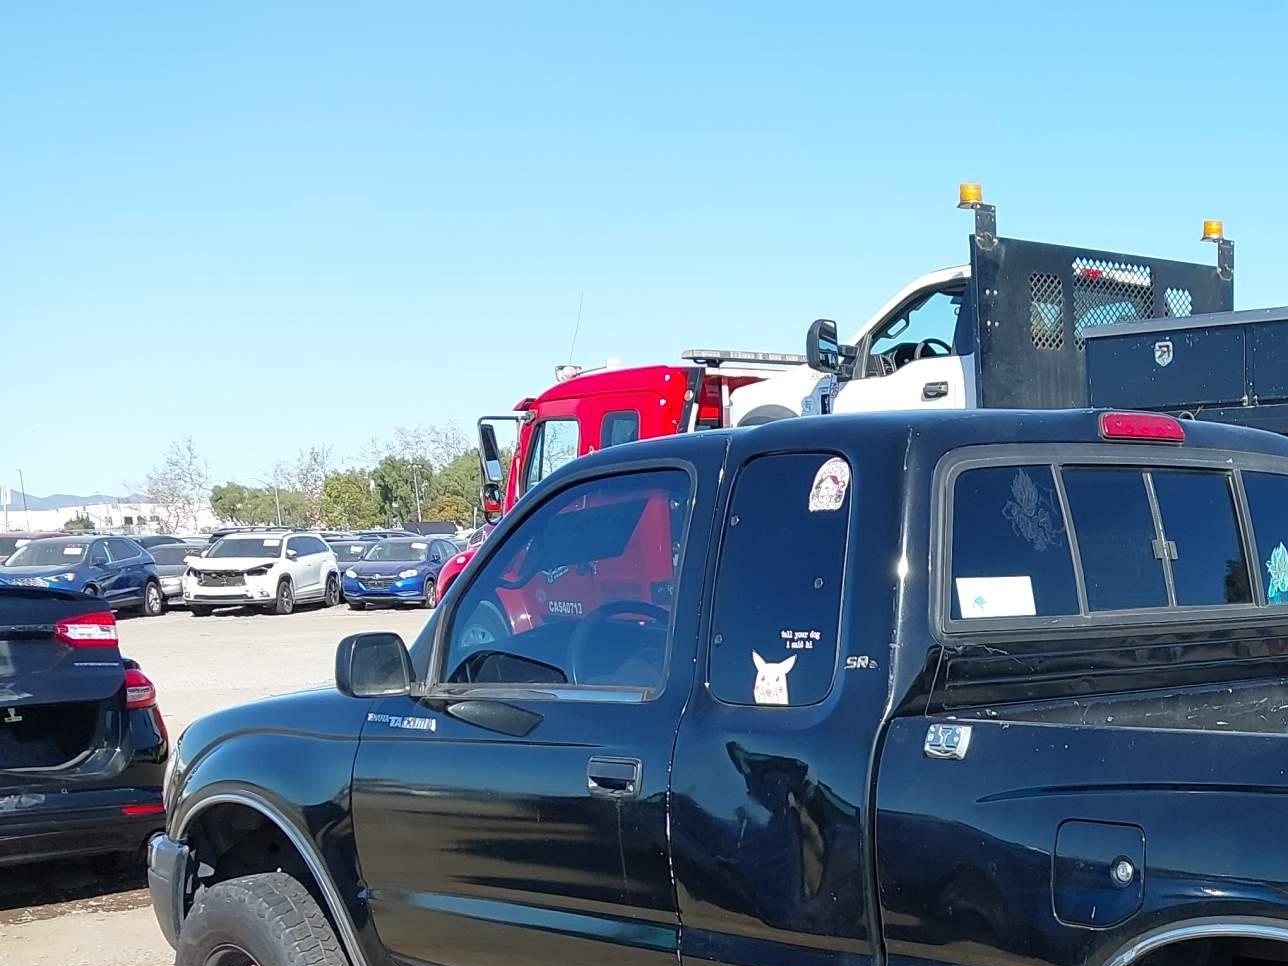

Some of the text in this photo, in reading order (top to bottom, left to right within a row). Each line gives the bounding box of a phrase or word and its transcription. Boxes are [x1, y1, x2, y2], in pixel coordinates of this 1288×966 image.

[794, 632, 809, 640] your
[810, 630, 820, 640] dog
[791, 641, 804, 649] said
[805, 641, 813, 649] hi
